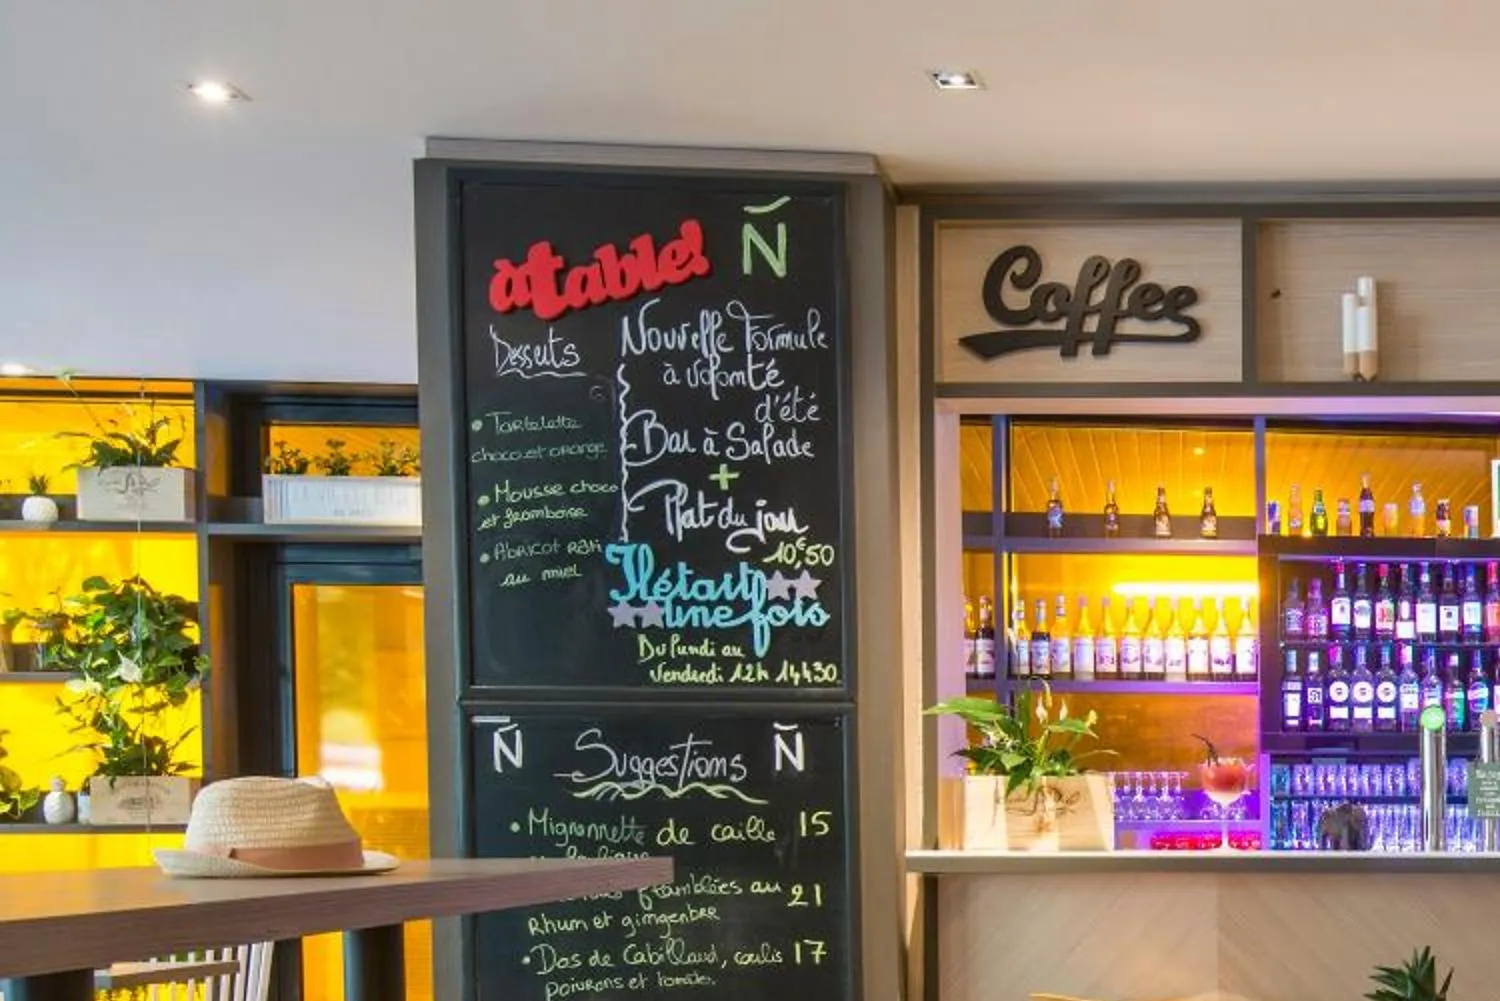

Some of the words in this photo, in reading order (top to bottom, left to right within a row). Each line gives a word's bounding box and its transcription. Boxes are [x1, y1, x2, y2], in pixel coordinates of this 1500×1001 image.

[959, 244, 1201, 358] Coffee
[620, 298, 734, 357] Nouvelle
[726, 300, 829, 351] Formule
[663, 361, 681, 386] à
[703, 427, 720, 456] à
[725, 422, 815, 465] Salade
[569, 480, 619, 494] choco
[627, 478, 720, 543] Plat
[717, 495, 748, 530] du
[721, 645, 745, 658] au
[657, 818, 695, 845] de
[800, 811, 832, 836] 15
[787, 884, 823, 906] 21
[594, 912, 614, 928] et
[530, 943, 581, 975] Dos
[589, 953, 614, 967] de
[794, 939, 827, 964] 17
[629, 974, 647, 990] et
